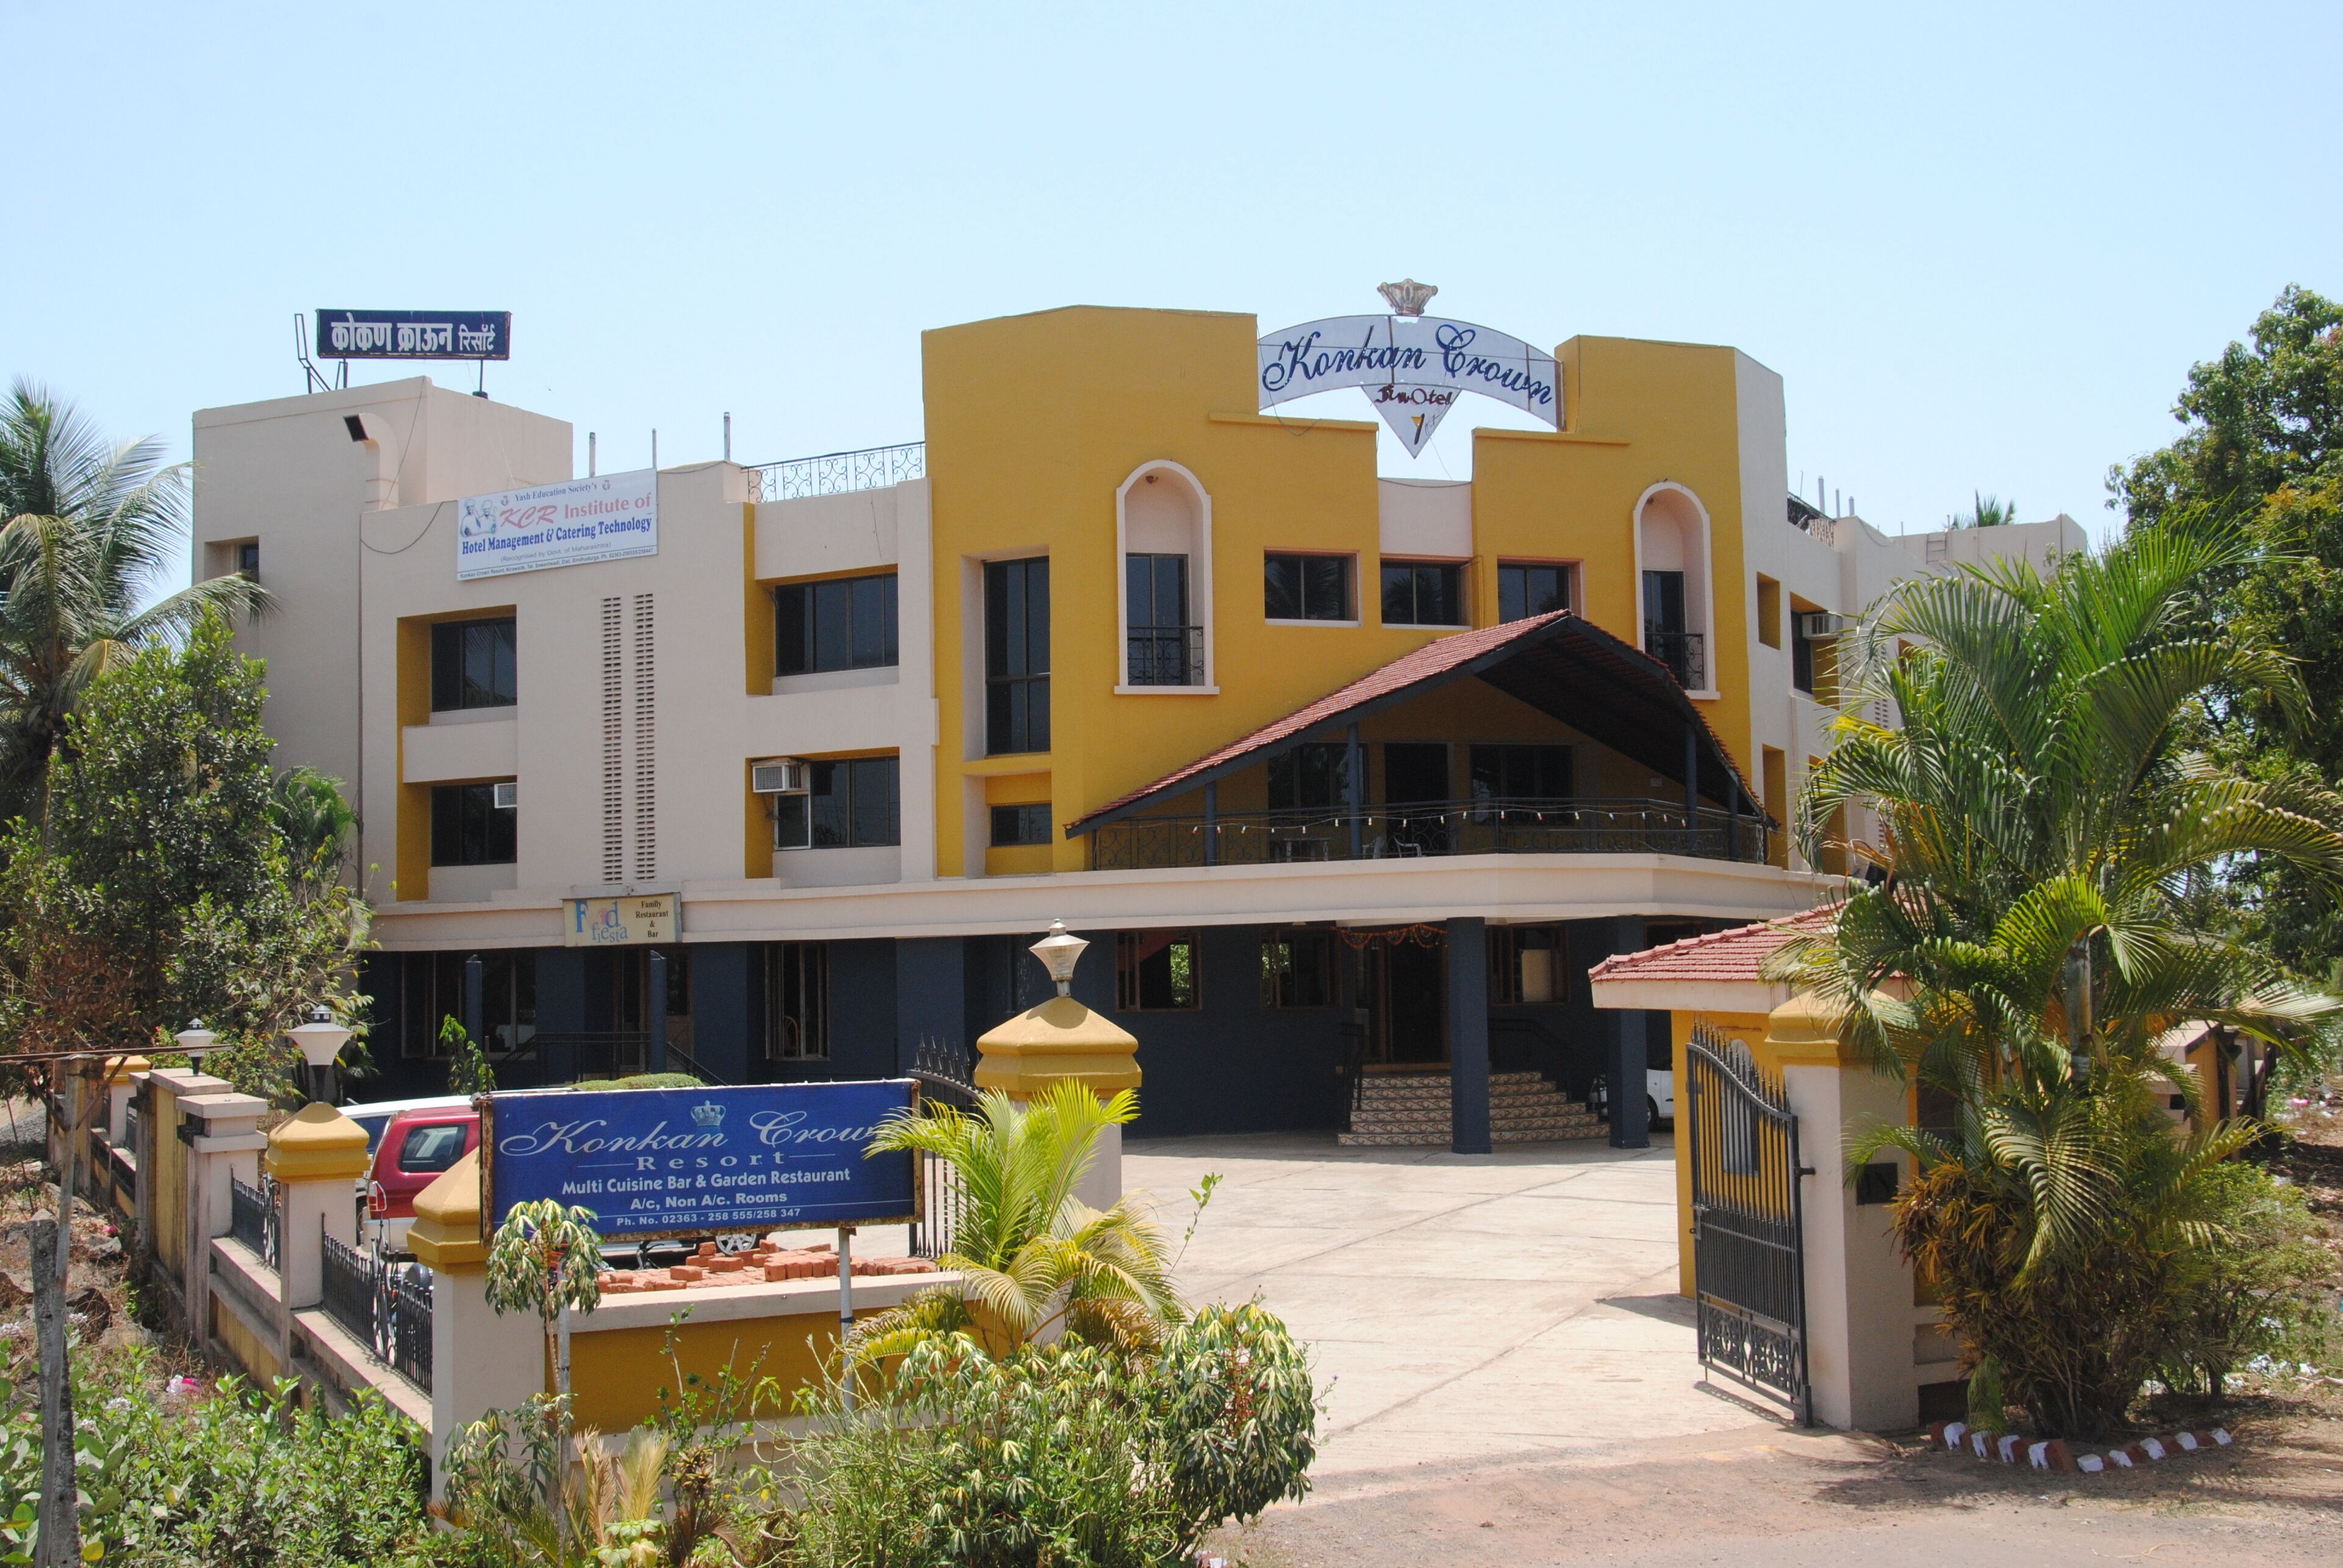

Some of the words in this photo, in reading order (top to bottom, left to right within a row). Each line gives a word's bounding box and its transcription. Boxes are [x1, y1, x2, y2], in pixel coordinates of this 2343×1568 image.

[331, 312, 392, 351] कोकण
[397, 322, 453, 352] क्राऊन
[458, 323, 496, 351] रिसॉर्ट
[1262, 325, 1427, 392] Konkan
[1435, 323, 1553, 405] Crown
[515, 492, 531, 502] Yash
[533, 489, 566, 500] Education
[568, 482, 597, 493] Society's
[499, 505, 558, 529] KCR
[564, 497, 630, 519] Institute
[635, 492, 652, 509] of
[462, 538, 486, 555] Hotel
[488, 531, 544, 551] Management
[546, 528, 554, 542] &
[556, 523, 596, 541] Catering
[598, 516, 652, 533] Technology
[635, 910, 669, 919] Restaurant
[641, 900, 662, 909] Family
[591, 922, 629, 943] fiesta
[647, 930, 659, 938] Bar
[499, 1119, 729, 1157] Konkan
[749, 1110, 877, 1148] Crow
[636, 1151, 785, 1171] Resort
[562, 1178, 603, 1195] Multi
[607, 1177, 663, 1193] Cuisine
[668, 1174, 692, 1190] Bar
[696, 1174, 707, 1188] &
[711, 1171, 766, 1188] Garden
[771, 1167, 851, 1184] Restaurant
[630, 1198, 660, 1212] A/c,
[666, 1196, 696, 1209] Non
[701, 1193, 731, 1206] A/c.
[736, 1192, 788, 1204] Rooms
[616, 1217, 635, 1226] Ph.
[639, 1216, 658, 1226] No.
[662, 1214, 697, 1224] 02363
[708, 1212, 729, 1221] 258
[732, 1209, 777, 1220] 555/258
[781, 1208, 801, 1218] 347
